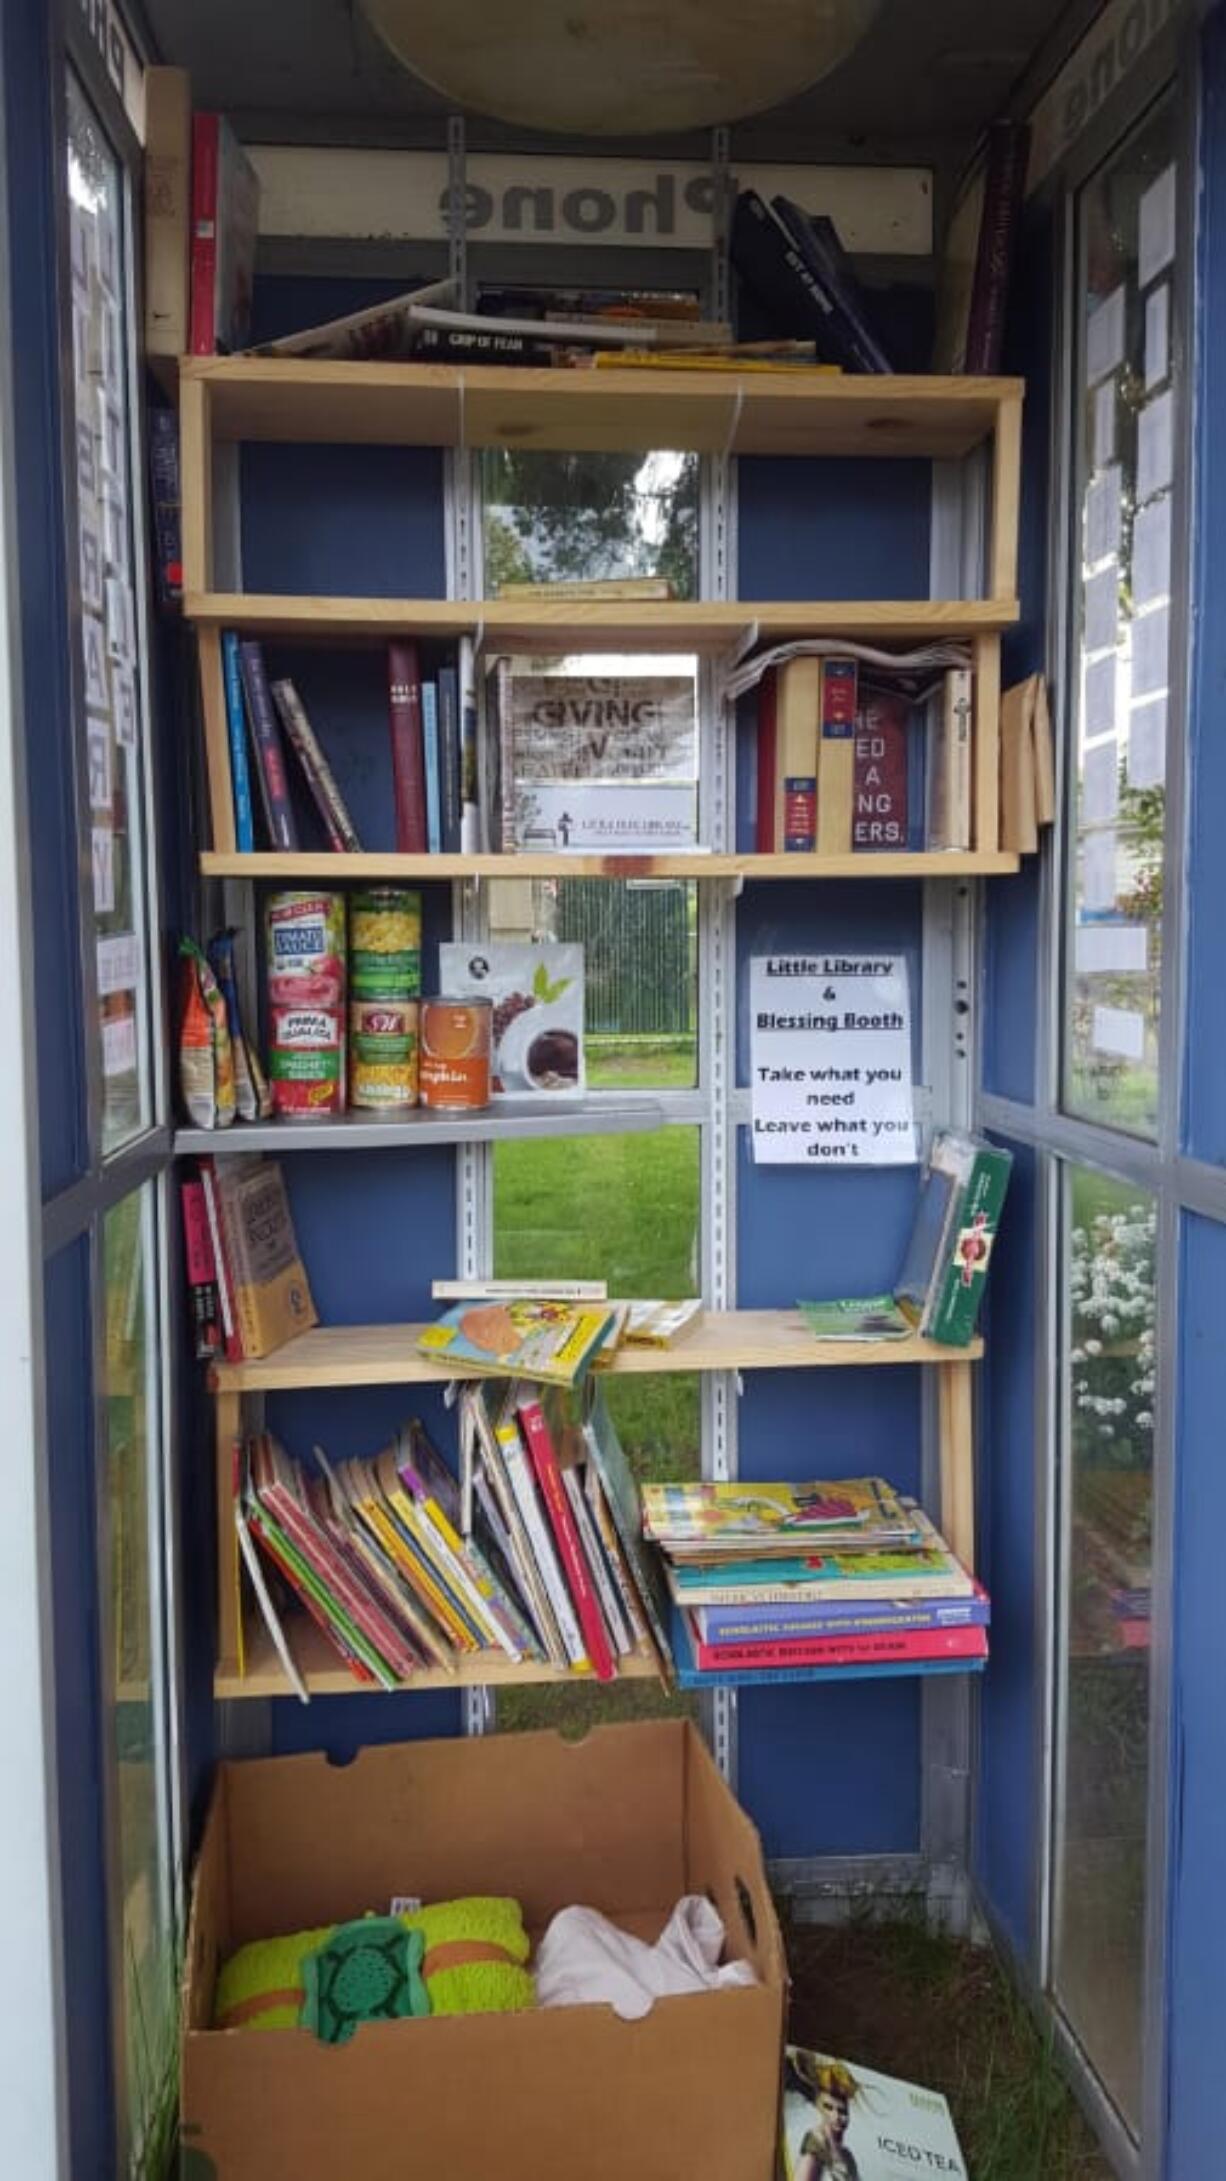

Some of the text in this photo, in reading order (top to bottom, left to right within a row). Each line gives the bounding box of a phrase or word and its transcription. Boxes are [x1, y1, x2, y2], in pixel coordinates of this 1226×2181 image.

[766, 959, 893, 976] Little Library
[822, 986, 836, 1001] &
[757, 1012, 903, 1032] Blessing Booth
[757, 1067, 902, 1085] Take what you
[806, 1092, 855, 1106] need
[754, 1118, 909, 1137] Leave what you
[807, 1142, 859, 1157] don't
[877, 2135, 961, 2173] ICED TEA
